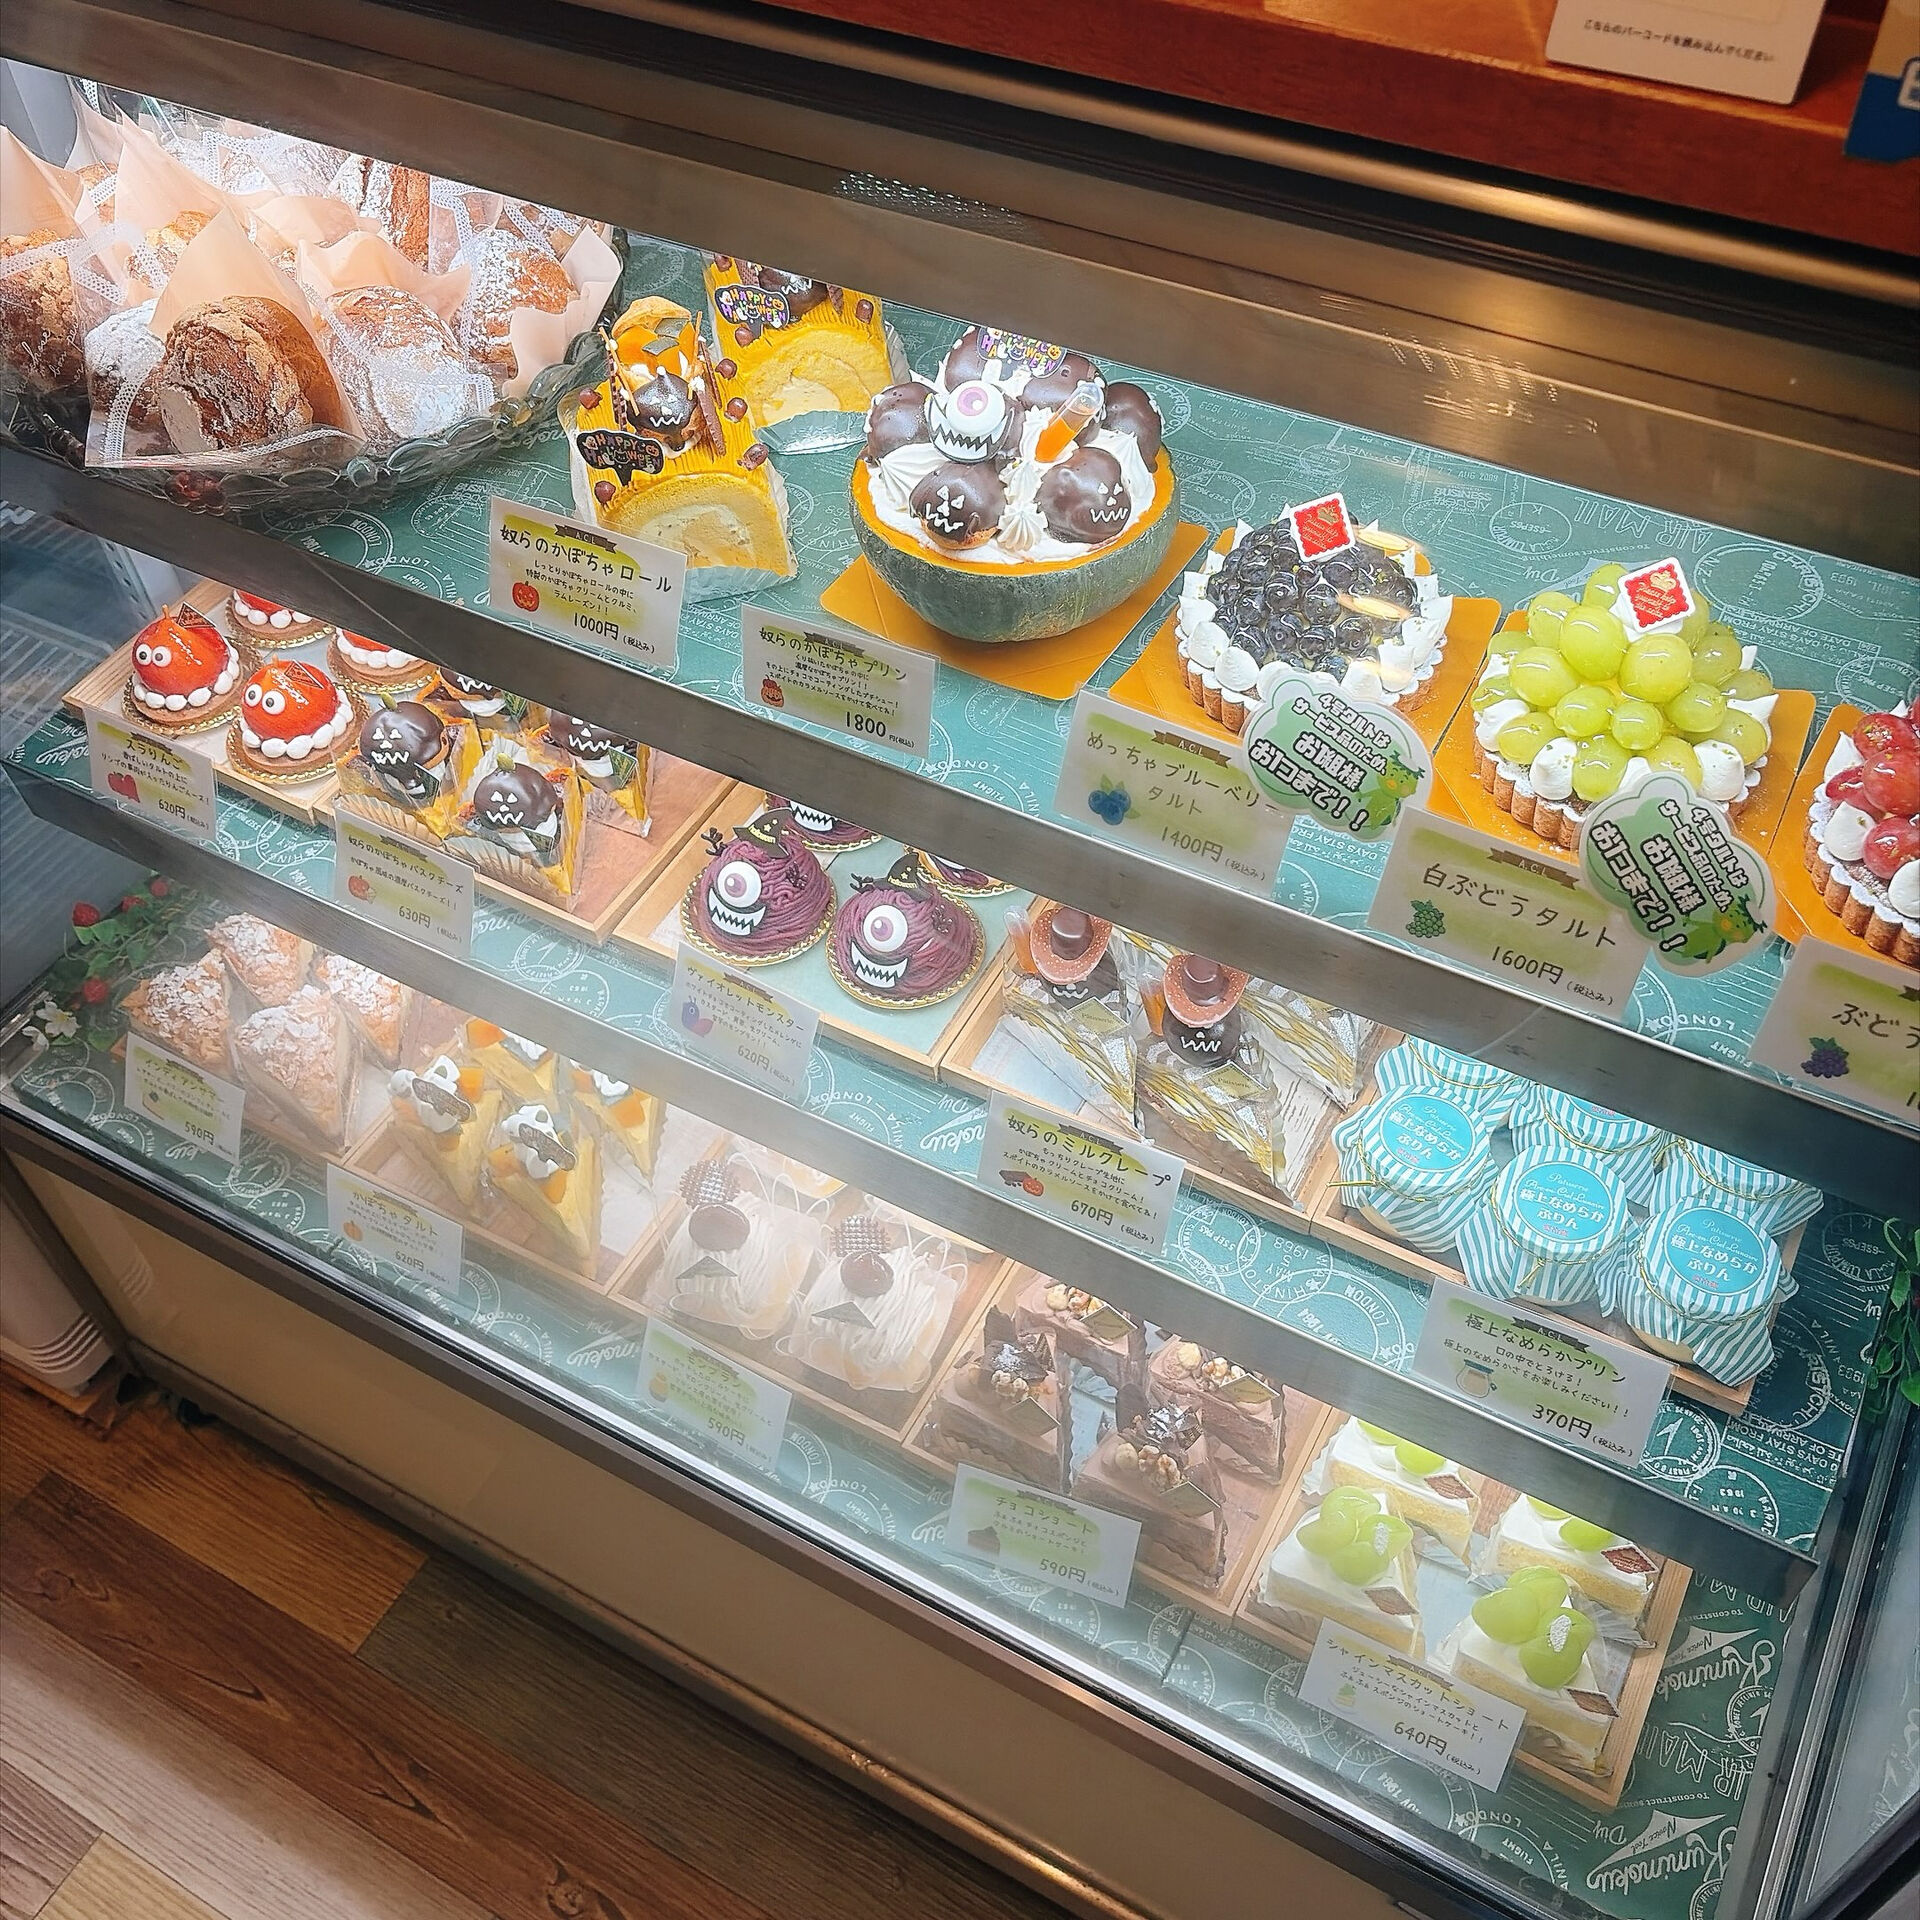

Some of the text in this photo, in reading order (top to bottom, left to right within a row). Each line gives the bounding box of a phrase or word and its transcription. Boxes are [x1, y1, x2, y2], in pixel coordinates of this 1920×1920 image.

[730, 289, 766, 307] HAPPY
[1575, 497, 1652, 539] MAIL
[500, 524, 671, 593] 奴らのかぼちゃロール
[526, 568, 637, 613] 特製のかぼちゃクリームとクルミ、
[534, 559, 633, 600] しっとりかぼちゃロールの中に
[573, 612, 619, 640] 1000円
[759, 627, 906, 680] 奴らのかぼちゃプリン
[795, 654, 870, 680] くり抜いたかぼちゃの中に
[845, 712, 886, 737] 1800
[1292, 697, 1388, 776] サービス品のため、
[1319, 693, 1391, 749] 4号タルトは
[126, 739, 183, 769] スラりんご
[1087, 731, 1279, 813] めっちゃブルーベリー
[159, 799, 185, 819] 620円
[1148, 786, 1203, 816] タルト
[1161, 826, 1223, 863] 1400円
[1346, 844, 1378, 860] DAYS
[1658, 799, 1734, 912] サービス品のため、
[1691, 807, 1748, 888] 4号タルトは
[349, 835, 464, 894] 奴らのかぼちゃバスクチーズ
[399, 905, 431, 928] 630円
[1422, 863, 1617, 949] 白ぶどうタルト
[1492, 946, 1564, 986] 1600円
[687, 967, 804, 1031] ヴァイオレットモンスター
[737, 1045, 770, 1071] 620円
[184, 1122, 215, 1145] 590円
[1007, 1114, 1171, 1187] 奴らのミルクレープ
[1018, 1147, 1145, 1203] かぼちゃクリームとチョコクリーム！
[1043, 1147, 1125, 1185] もっちりクレープ生地に
[353, 1192, 438, 1236] かぼちゃタルト
[1071, 1200, 1113, 1226] 670円
[1520, 1188, 1605, 1223] 極上なめらか
[1537, 1209, 1579, 1231] ぷりん
[1670, 1234, 1759, 1275] 極上なめらか
[1687, 1259, 1732, 1283] ぷりん
[1344, 1283, 1390, 1328] LONDON
[1465, 1313, 1626, 1384] 極上なめらかプリン
[1496, 1346, 1582, 1387] 口の中でとろける！
[688, 1353, 741, 1388] モンブラン
[1443, 1338, 1629, 1418] 極上のなめらかさをお楽しみください！！
[708, 1417, 745, 1446] 590円
[1532, 1403, 1592, 1439] 370円
[1766, 1437, 1795, 1455] STAY
[1797, 1450, 1828, 1467] DAYS
[1809, 1443, 1825, 1455] OF
[995, 1497, 1093, 1535] チョコショート
[1040, 1559, 1086, 1583] 590円
[1326, 1638, 1510, 1732] シャインマスカットショート
[1352, 1666, 1480, 1732] ジューシーなシャインマスカットと
[1394, 1721, 1448, 1756] 640円
[1646, 1792, 1696, 1806] construct
[1696, 1791, 1709, 1800] To
[1501, 1837, 1535, 1867] FLIGHT
